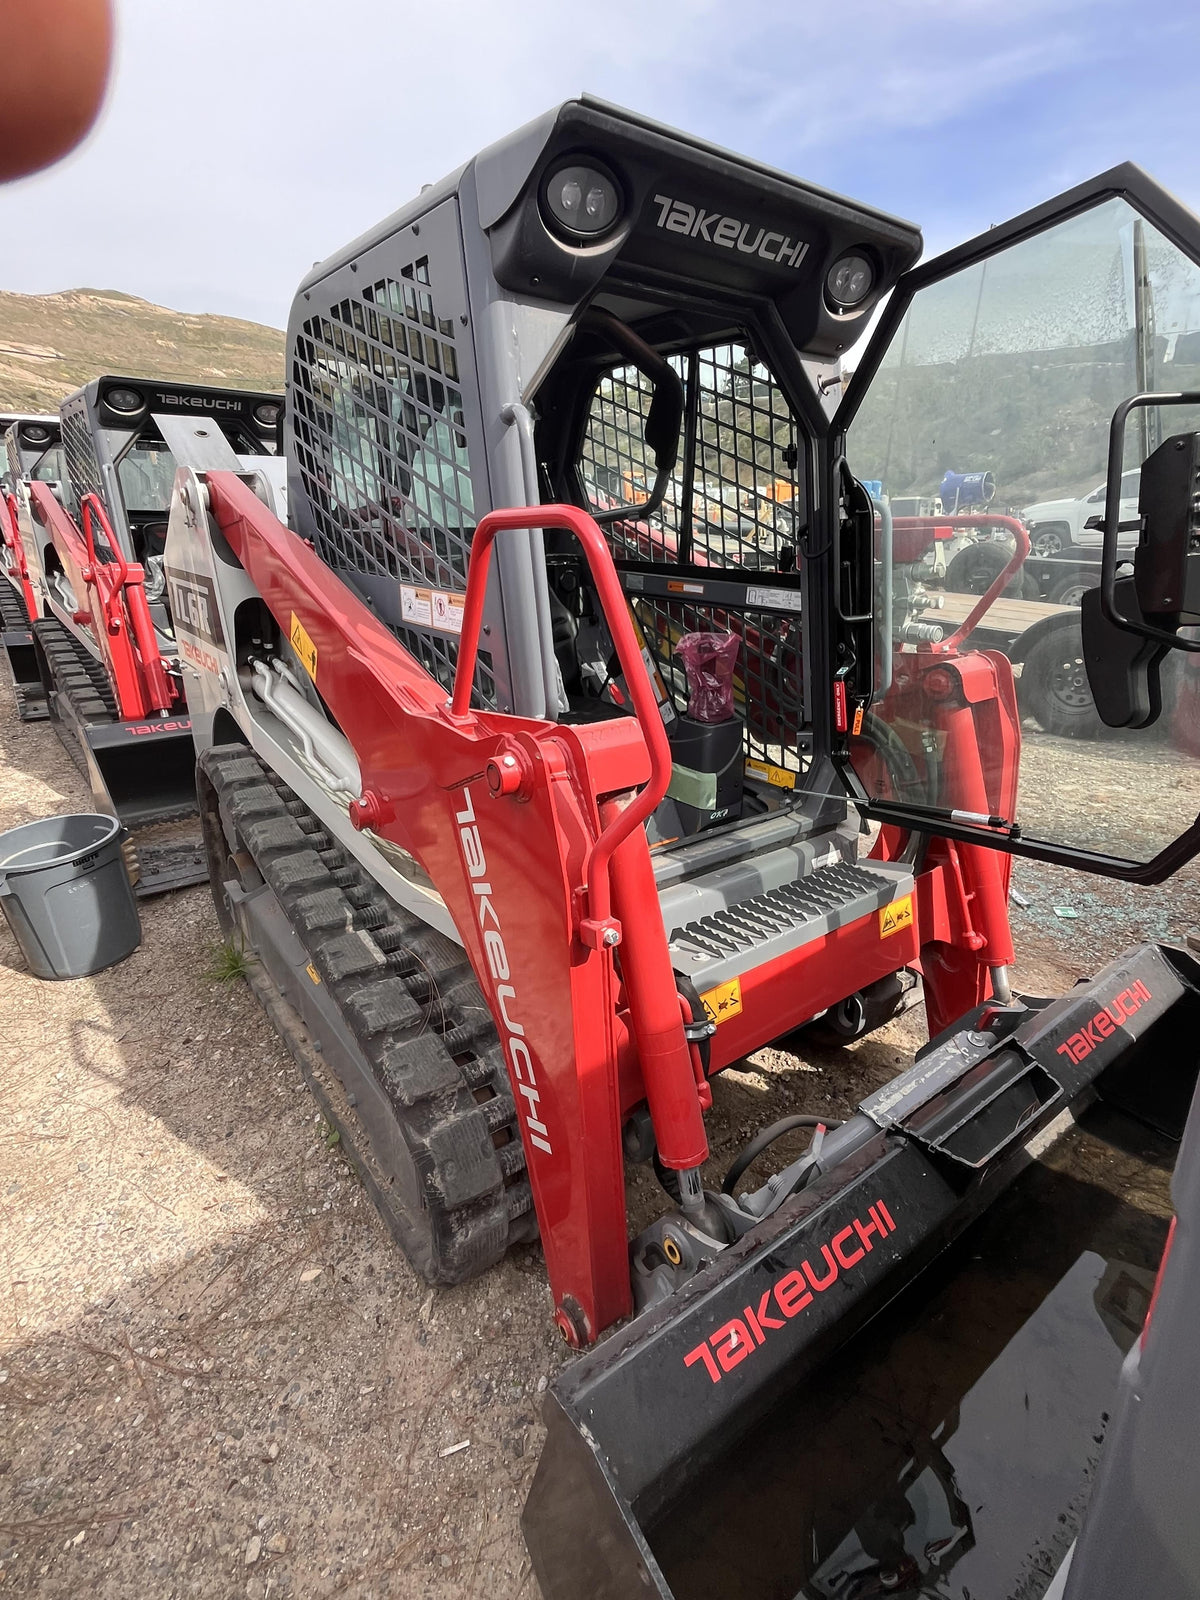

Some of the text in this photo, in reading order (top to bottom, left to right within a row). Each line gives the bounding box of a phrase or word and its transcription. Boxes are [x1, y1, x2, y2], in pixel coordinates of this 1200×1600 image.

[654, 194, 810, 269] TAKEUCHI
[156, 393, 242, 411] TAKEUCHI
[169, 576, 212, 635] TL6R
[456, 787, 552, 1154] TAKEUCHI
[1056, 978, 1152, 1065] TAKEUCHI
[683, 1199, 897, 1383] TAKEUCHI
